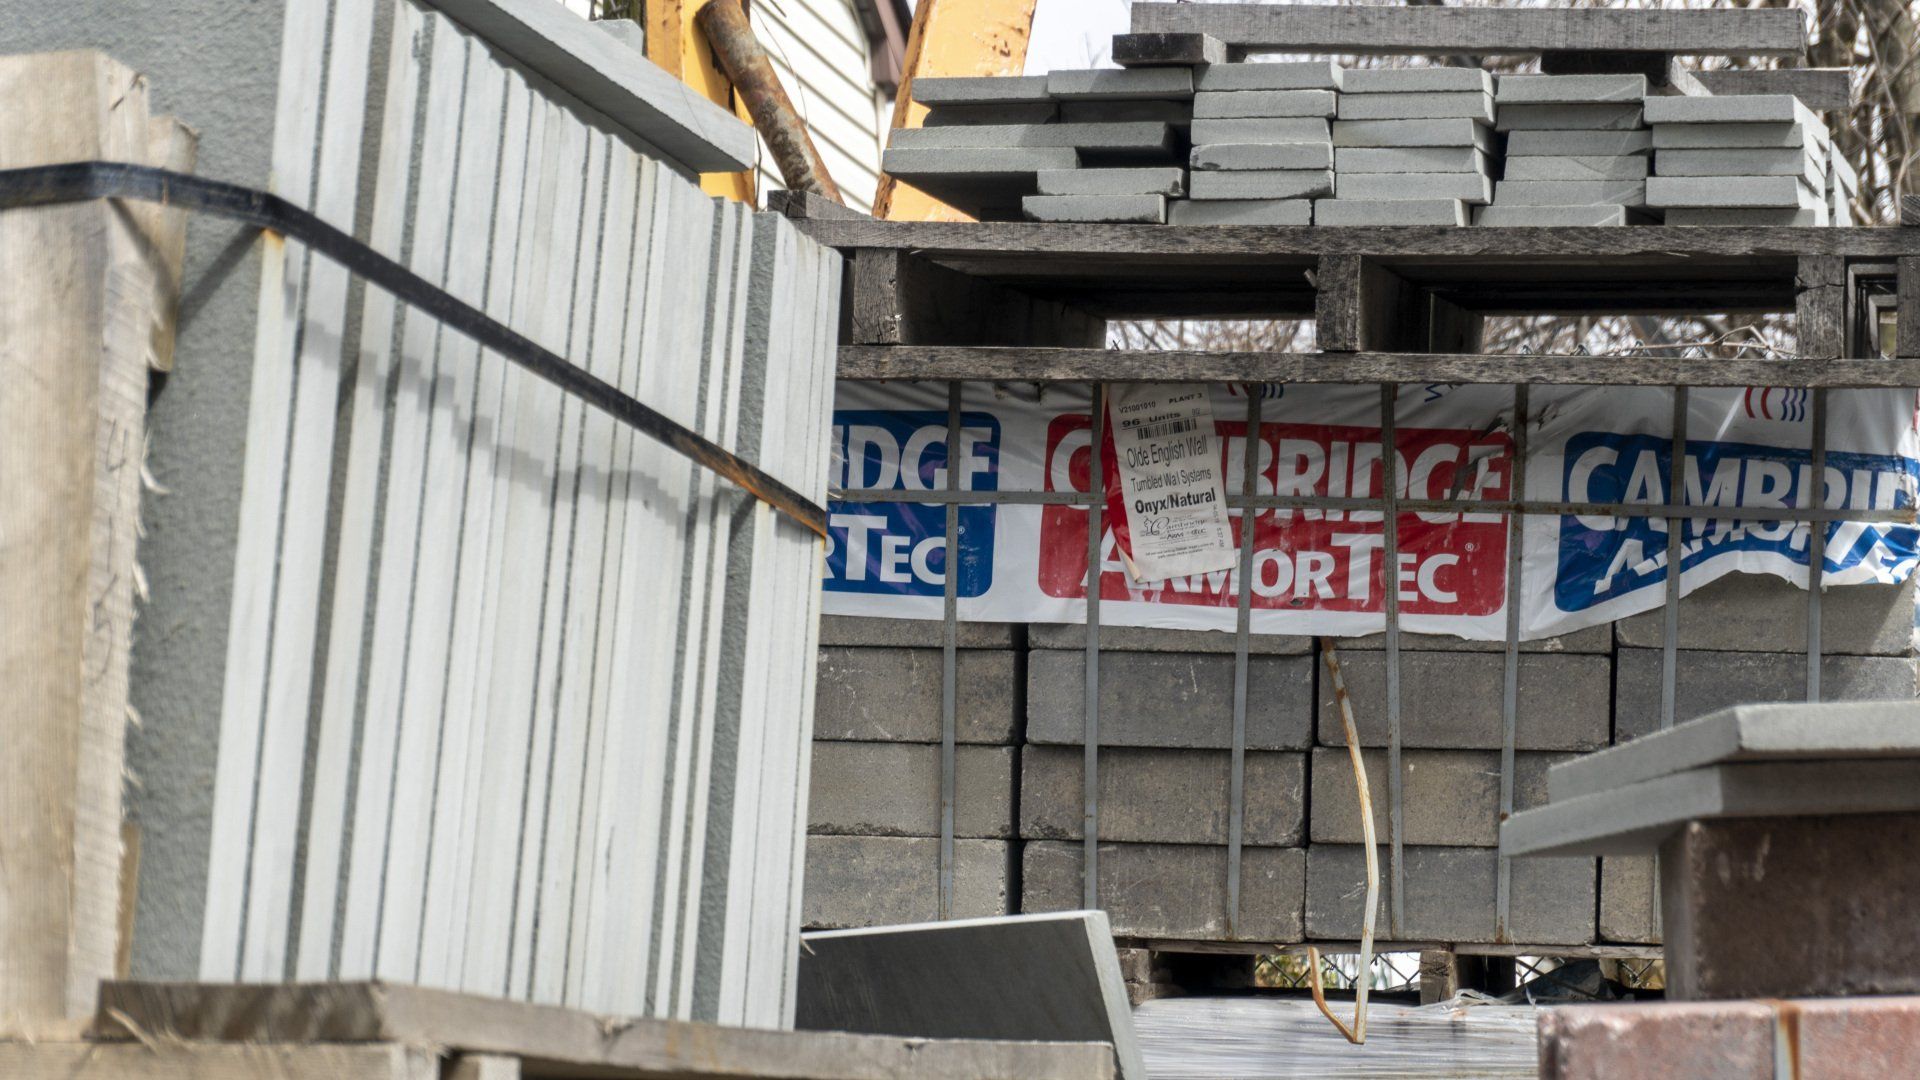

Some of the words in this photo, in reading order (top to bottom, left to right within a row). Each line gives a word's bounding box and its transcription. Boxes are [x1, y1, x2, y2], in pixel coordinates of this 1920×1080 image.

[1168, 394, 1195, 404] PLANT
[1121, 417, 1141, 428] 96
[1149, 411, 1181, 423] Units
[1126, 445, 1150, 469] Olde
[1151, 440, 1186, 467] English
[1187, 434, 1208, 456] Wall
[1130, 473, 1163, 493] Tumbled
[1163, 471, 1180, 487] Wal
[1180, 468, 1212, 488] Systems
[1135, 486, 1216, 515] Onyx/Natural
